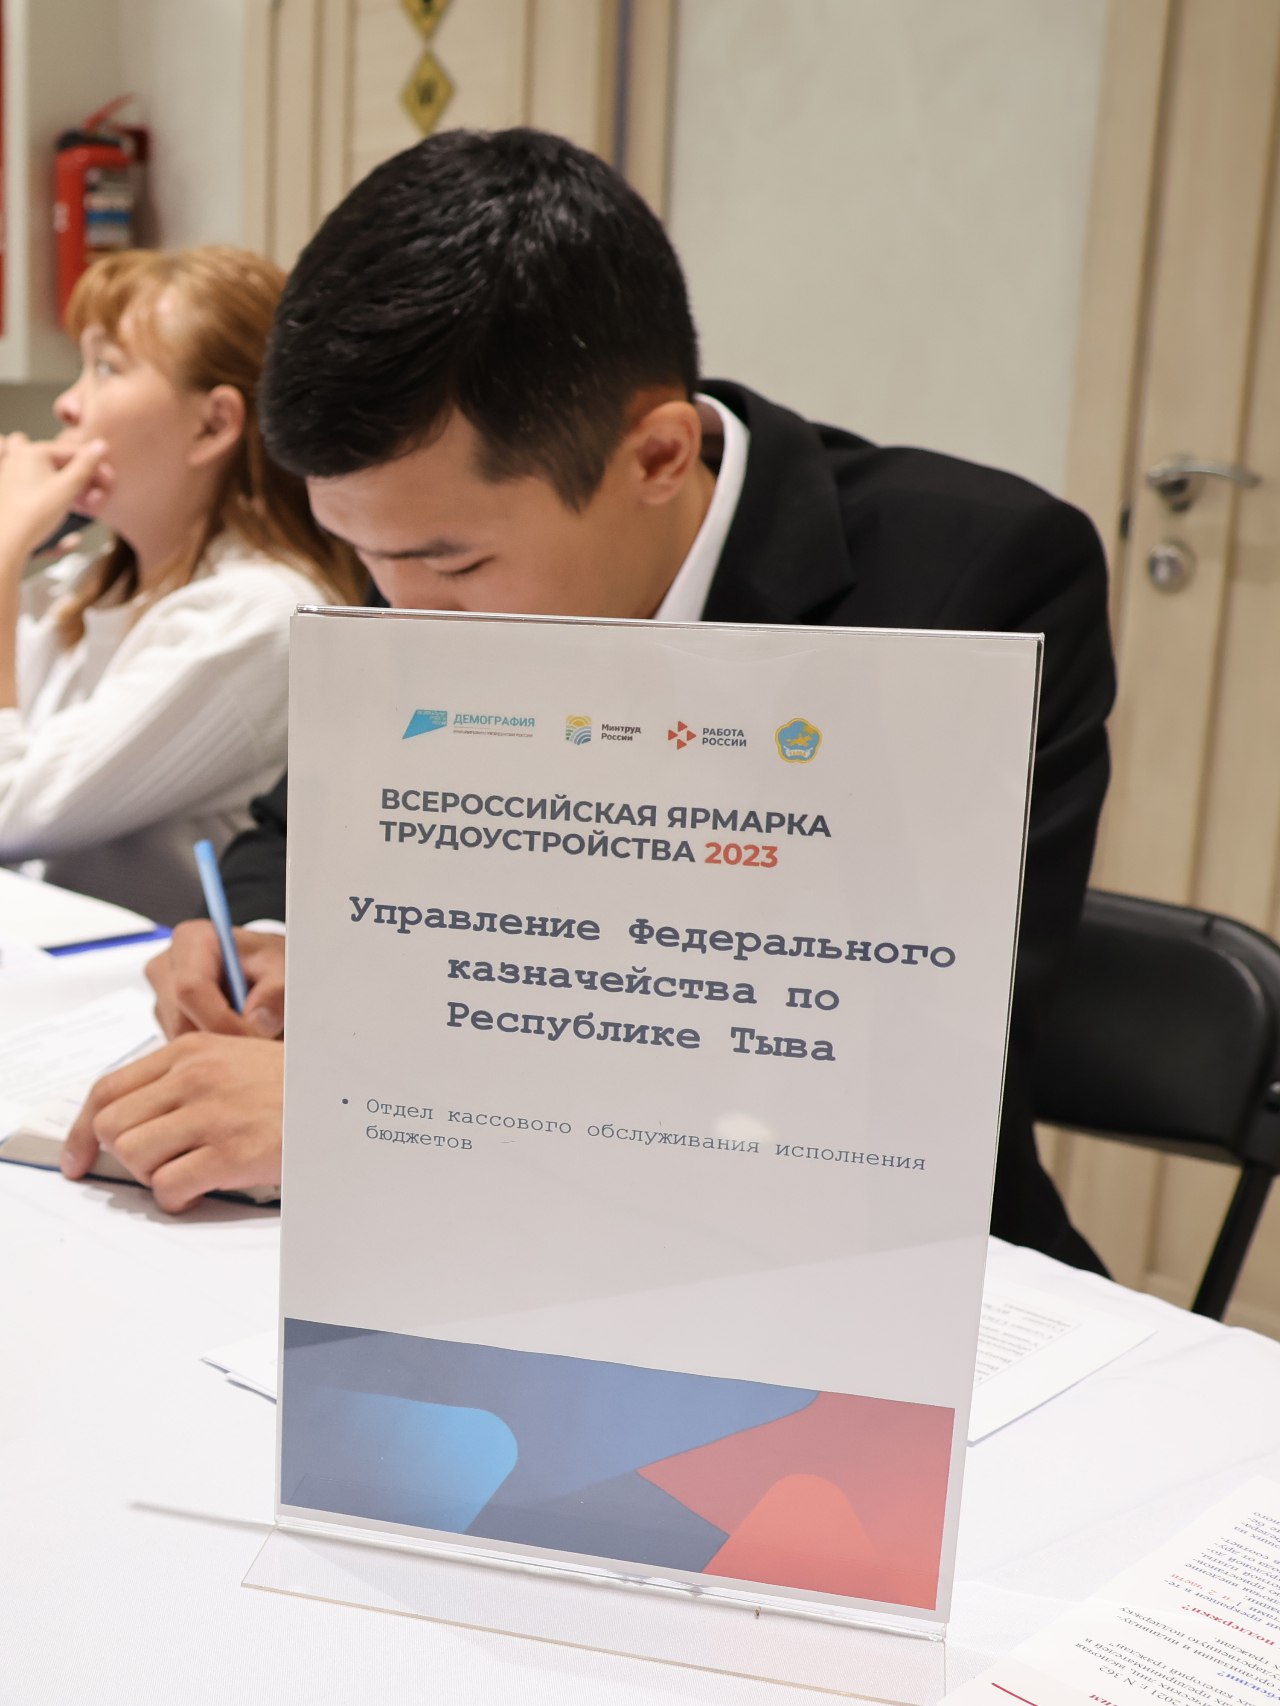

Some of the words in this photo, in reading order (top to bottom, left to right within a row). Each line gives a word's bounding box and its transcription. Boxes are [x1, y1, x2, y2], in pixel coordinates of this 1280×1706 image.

[454, 713, 536, 727] ДЕМОГРАФИЯ
[601, 723, 642, 734] Минтруд
[601, 732, 634, 741] России
[702, 727, 745, 738] РАБОТА
[702, 737, 747, 747] РОССИИ
[382, 788, 657, 827] ВСЕРОССИЙСКАЯ
[668, 807, 831, 837] ЯРМАРКА
[379, 821, 696, 863] ТРУДОУСТРОЙСТВА
[704, 842, 778, 868] 2023
[349, 896, 600, 940] Управление
[629, 919, 955, 968] Федерального
[447, 959, 757, 1004] казначейства
[786, 988, 839, 1011] по
[447, 1002, 700, 1049] Республике
[731, 1027, 836, 1061] Тыва
[366, 1125, 472, 1149] бюджетов
[367, 1099, 433, 1119] Отдел
[448, 1111, 571, 1133] кассового
[588, 1124, 759, 1153] обслуживания
[776, 1145, 925, 1170] исполнения
